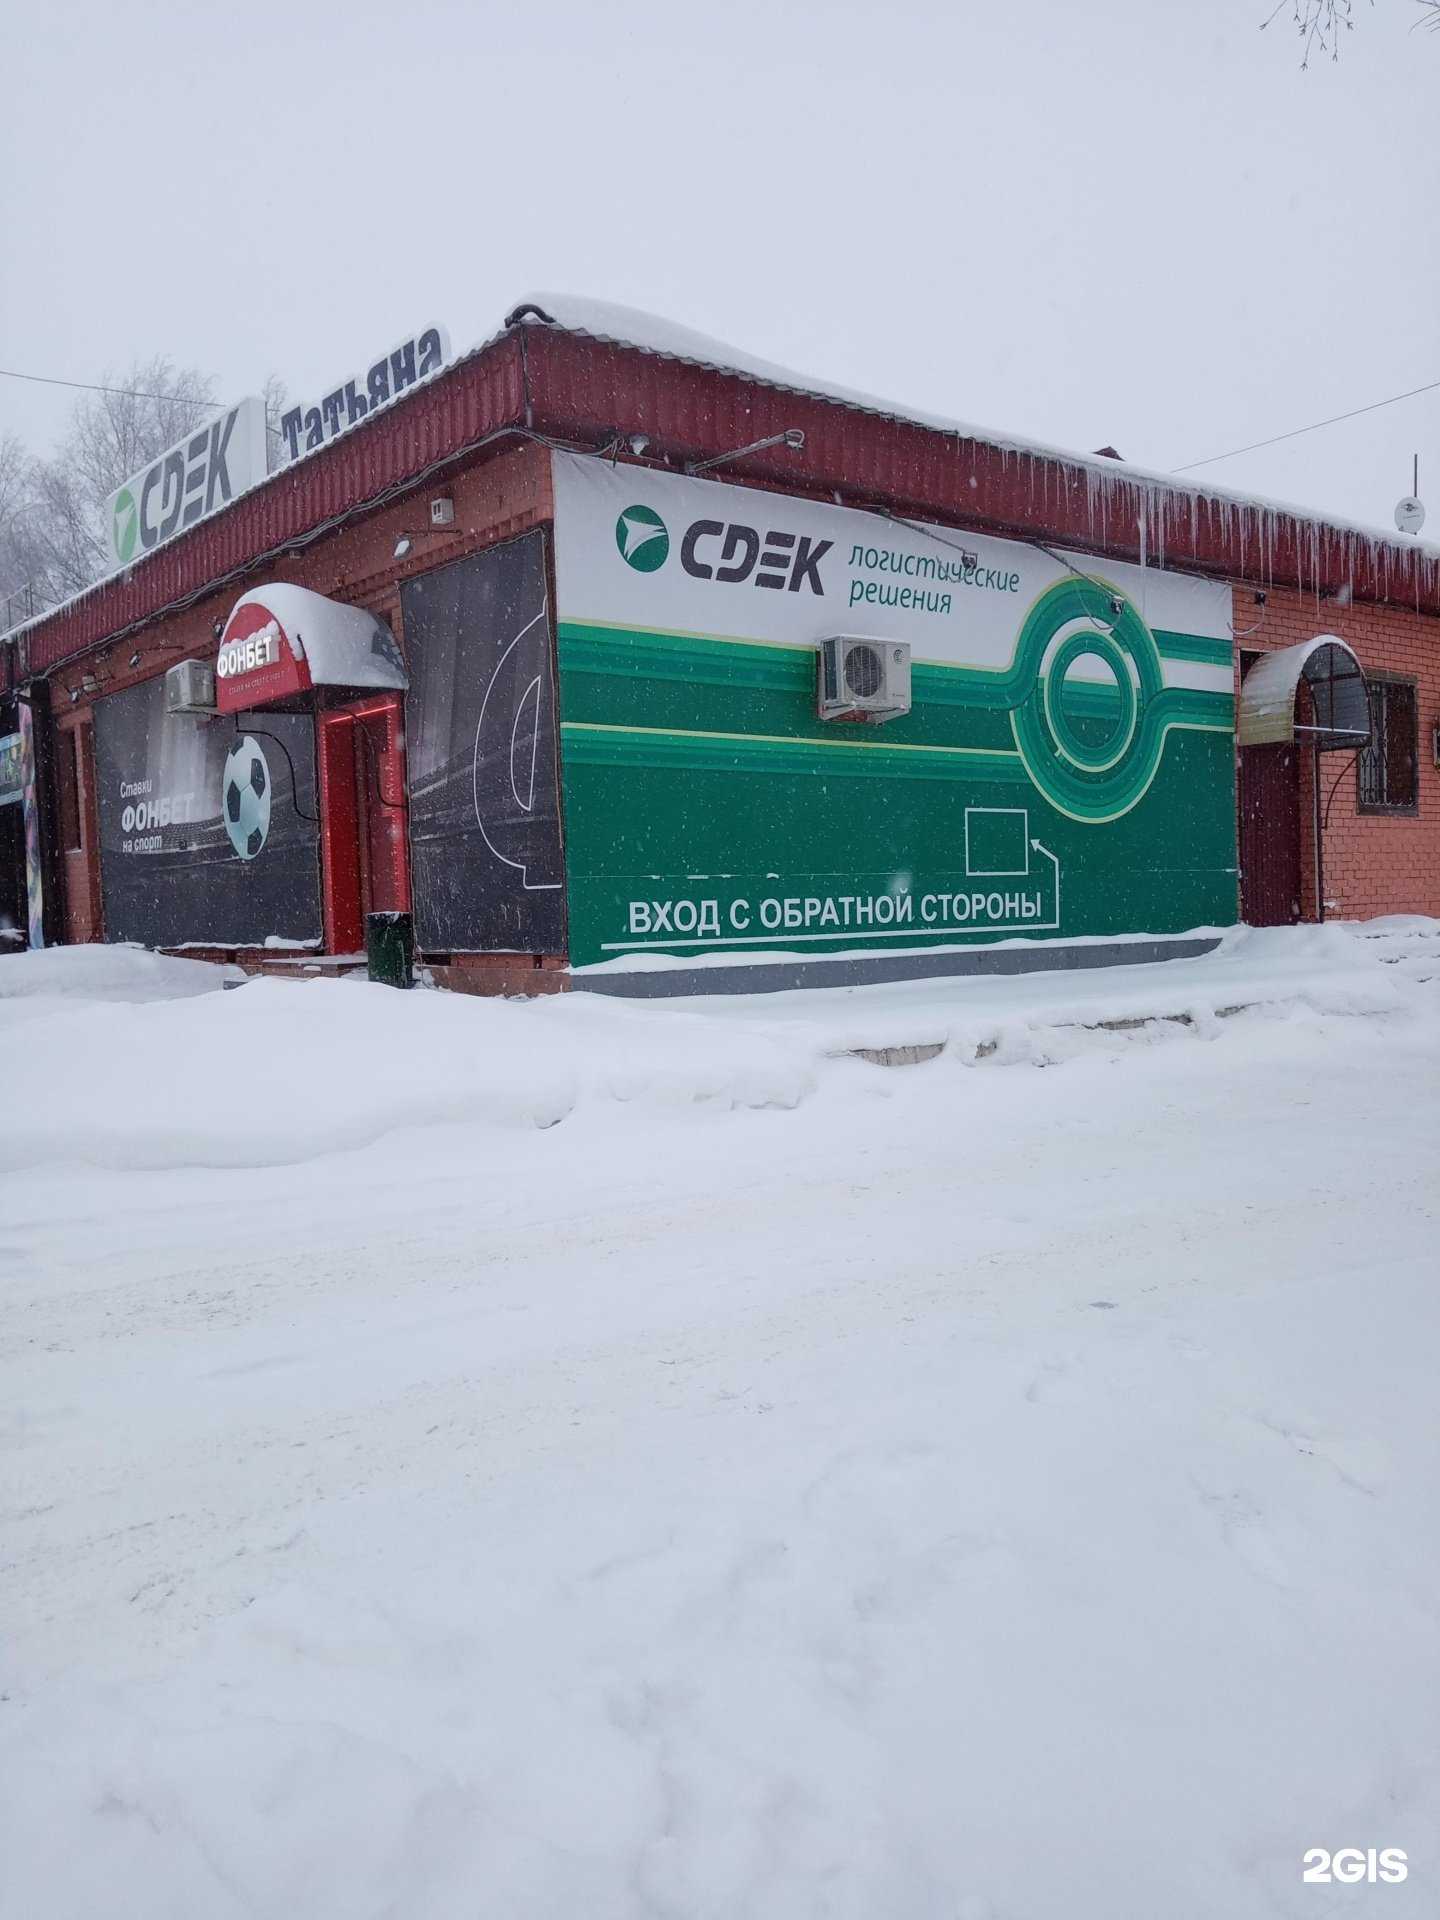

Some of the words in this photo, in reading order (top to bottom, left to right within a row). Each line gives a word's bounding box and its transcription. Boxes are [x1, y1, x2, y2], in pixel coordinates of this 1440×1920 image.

[280, 328, 443, 460] Татьяна
[849, 545, 1020, 592] логистические
[849, 579, 952, 614] решения
[217, 635, 272, 678] ФОНБЕТ
[120, 779, 152, 798] Ставки
[122, 839, 133, 853] на
[134, 835, 162, 854] спорт
[629, 900, 721, 936] ВХОД
[729, 898, 751, 930] С
[759, 887, 913, 930] ОБРАТНОЙ
[920, 891, 1041, 922] СТОРОНЫ
